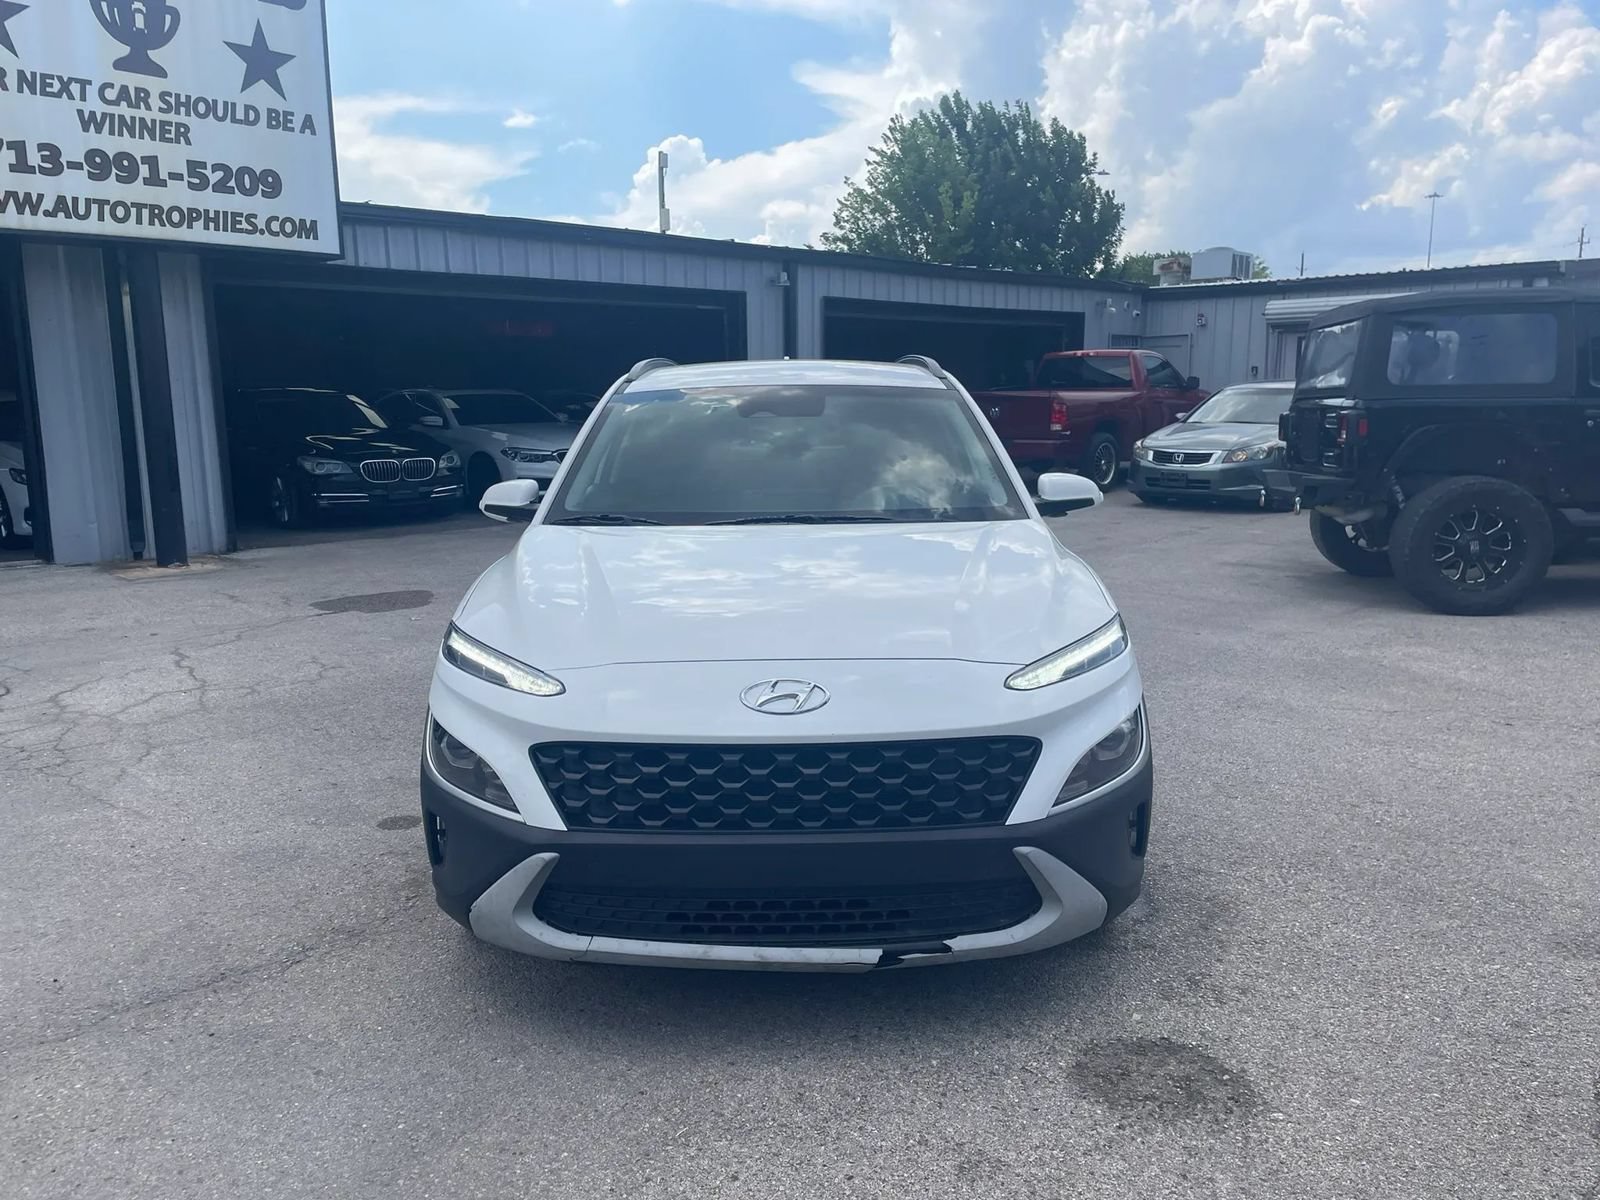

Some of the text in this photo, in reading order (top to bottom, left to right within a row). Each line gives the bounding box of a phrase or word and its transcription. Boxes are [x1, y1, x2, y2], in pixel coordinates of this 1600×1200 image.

[16, 69, 92, 103] NEXT
[98, 81, 152, 112] CAR
[158, 90, 261, 127] SHOULD
[266, 107, 295, 133] BE
[299, 114, 317, 136] A
[76, 108, 192, 147] WINNER
[0, 138, 283, 200] 13-991-5209
